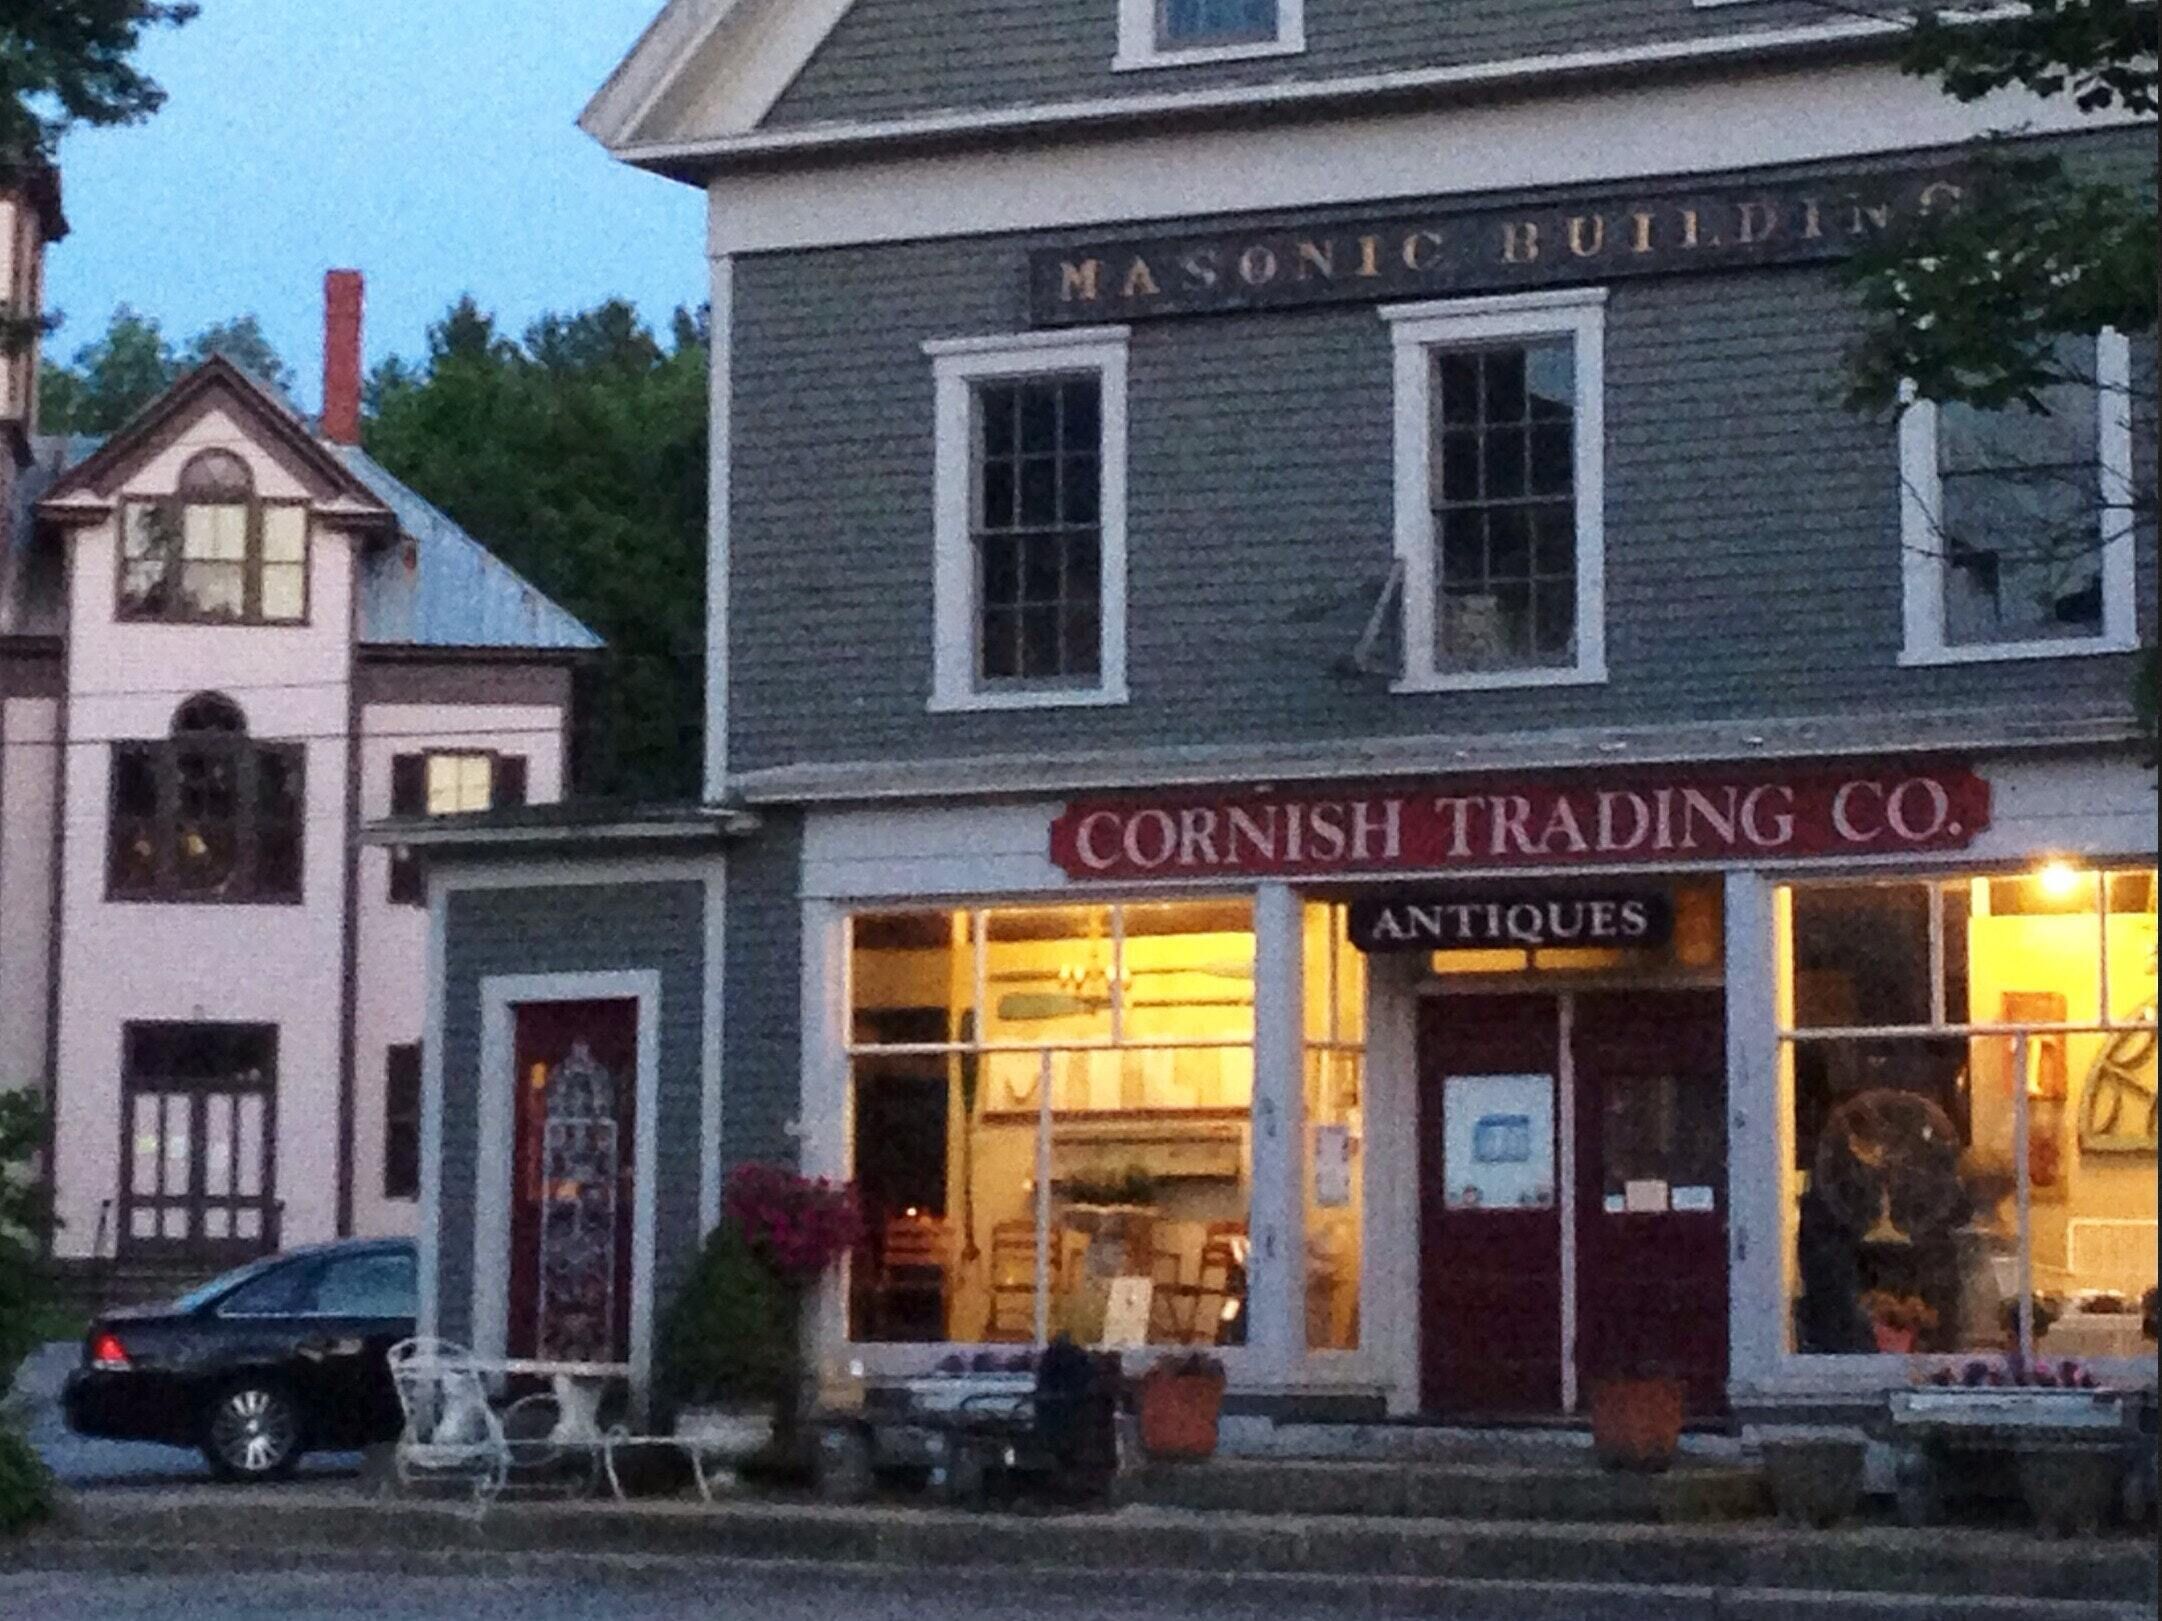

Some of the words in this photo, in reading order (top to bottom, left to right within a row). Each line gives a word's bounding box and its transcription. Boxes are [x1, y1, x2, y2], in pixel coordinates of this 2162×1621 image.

[1060, 231, 1443, 301] MASONIC
[1075, 799, 1401, 869] CORNISH
[1435, 784, 1794, 856] TRADING
[1831, 777, 1963, 843] CO.
[1372, 901, 1648, 941] ANTIQUES
